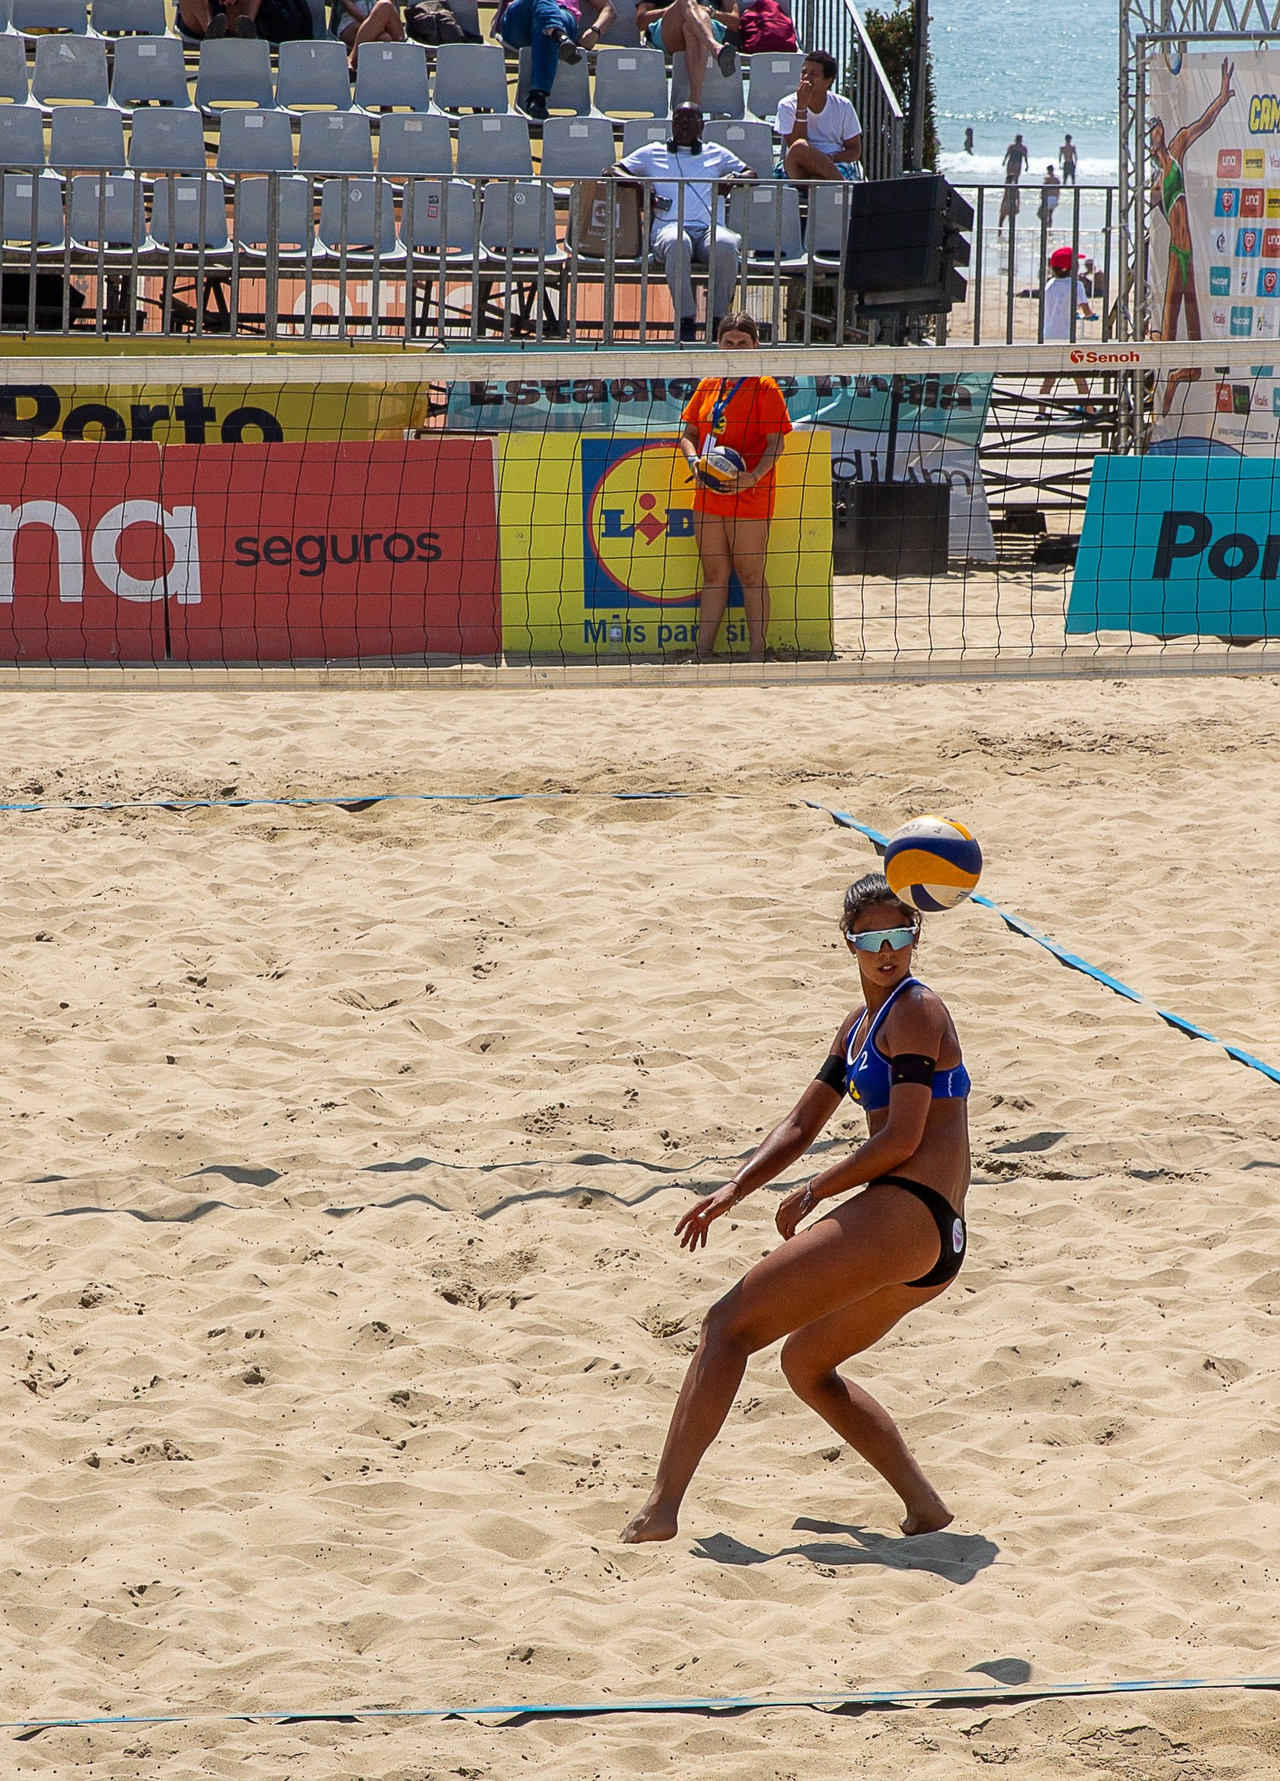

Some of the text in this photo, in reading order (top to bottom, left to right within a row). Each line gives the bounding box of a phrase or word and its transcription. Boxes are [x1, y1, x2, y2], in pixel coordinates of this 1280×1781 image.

[1085, 351, 1140, 363] Senoh
[601, 492, 695, 547] LID
[234, 531, 442, 577] seguros
[584, 613, 646, 644] Mis
[658, 624, 702, 649] par
[858, 1050, 869, 1072] 2
